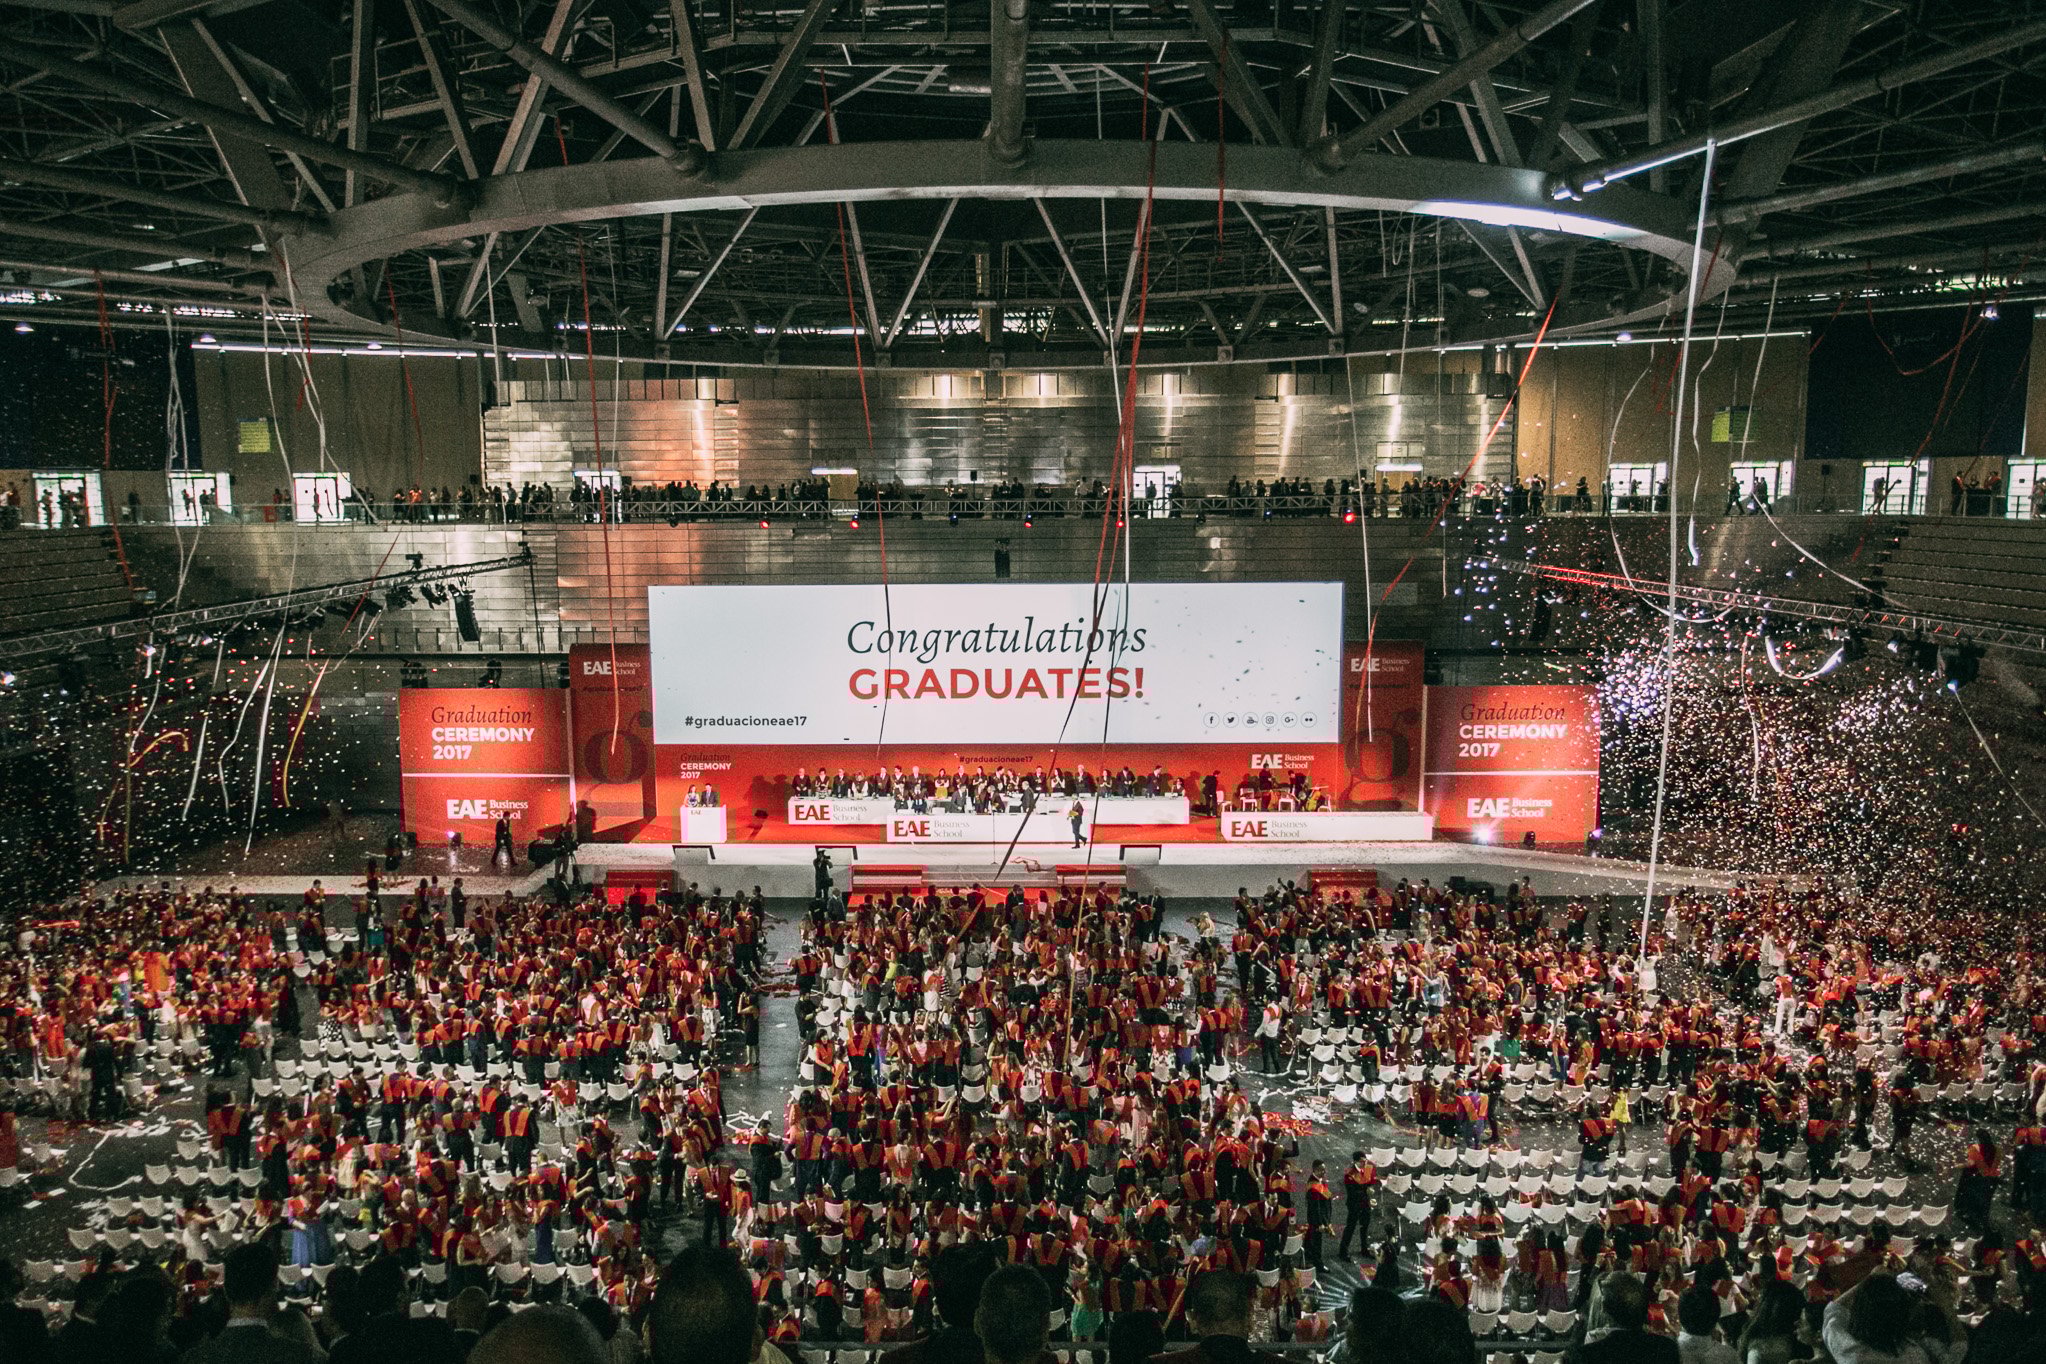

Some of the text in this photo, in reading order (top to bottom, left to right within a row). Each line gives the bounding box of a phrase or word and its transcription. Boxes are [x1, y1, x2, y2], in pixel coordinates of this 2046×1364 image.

[847, 616, 1147, 664] Congratulations
[583, 661, 612, 675] EAE
[1350, 657, 1380, 672] EAE
[849, 667, 1144, 700] GRADUATES!
[431, 704, 533, 724] Graduation
[1460, 701, 1566, 721] Graduation
[685, 715, 807, 729] #graduacioneae17
[431, 727, 535, 742] CEREMONY
[1459, 724, 1569, 739] CEREMONY
[432, 744, 473, 760] 2017
[680, 752, 731, 762] Graduation
[1458, 742, 1501, 757] 2017
[680, 762, 732, 770] CEREMONY
[959, 756, 1033, 764] #graduacioneae17
[1251, 754, 1283, 769] EAE
[680, 771, 701, 779] 2017
[446, 799, 529, 820] EAE Business
[794, 805, 831, 821] EAE
[1467, 798, 1553, 818] EAE Business
[1511, 808, 1545, 818] School
[833, 813, 861, 821] School
[894, 820, 970, 837] EAE Business
[933, 829, 963, 838] School
[1231, 821, 1268, 837] EAE
[1270, 829, 1300, 838] School
